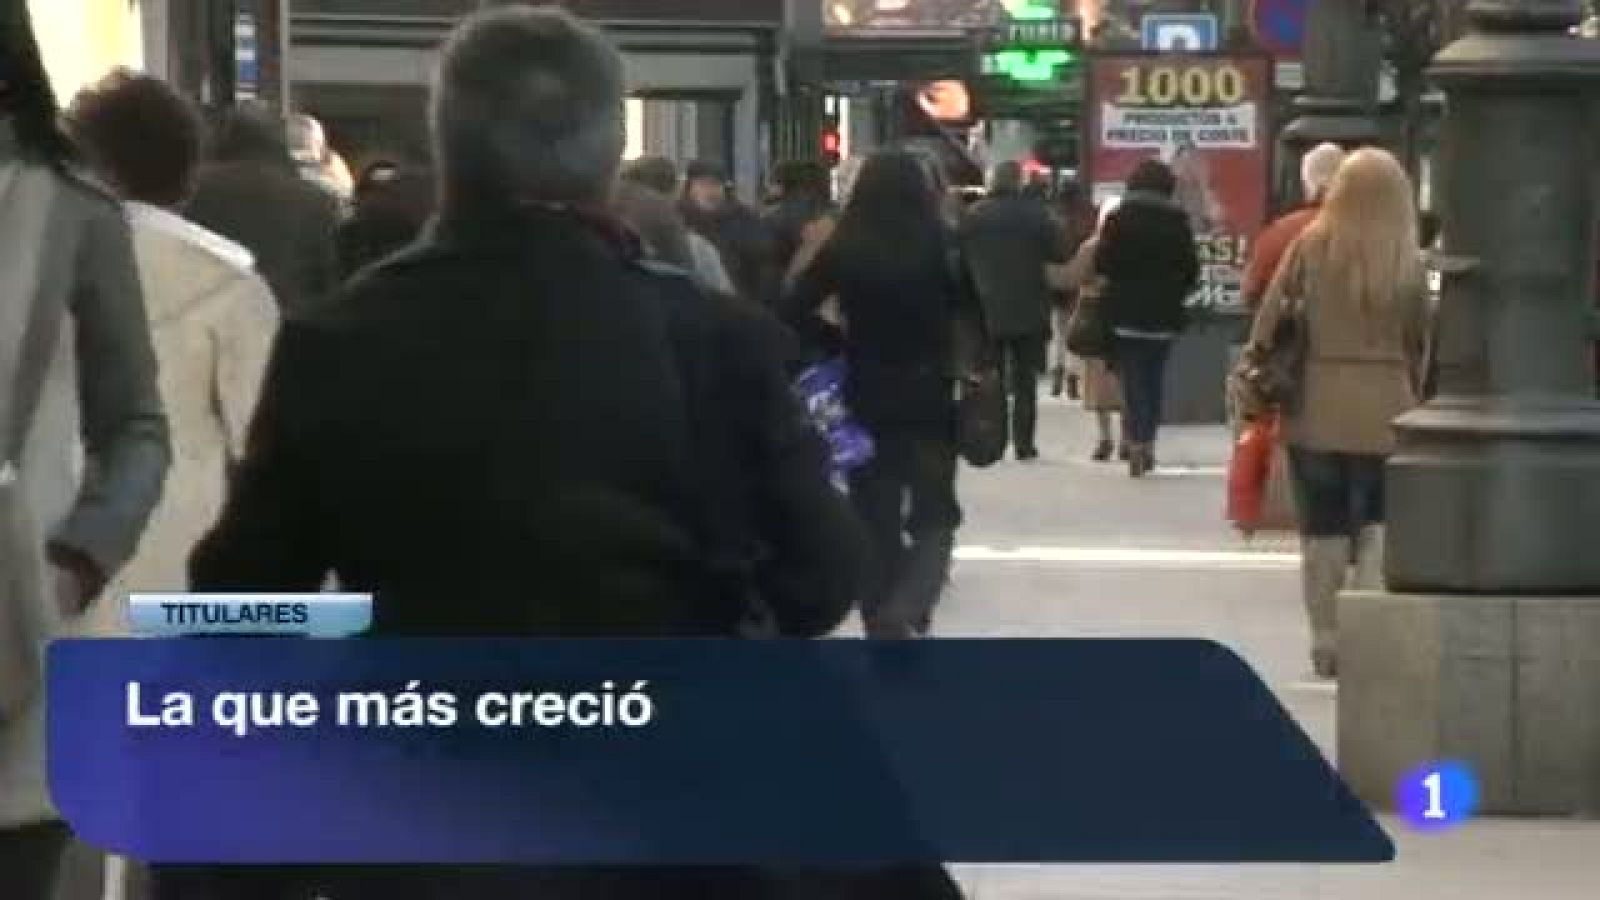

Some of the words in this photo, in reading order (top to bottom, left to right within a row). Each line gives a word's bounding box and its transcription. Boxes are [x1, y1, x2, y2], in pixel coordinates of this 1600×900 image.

[1117, 64, 1244, 104] 1000
[1106, 129, 1167, 142] PRECIO
[1198, 129, 1249, 143] COSTE
